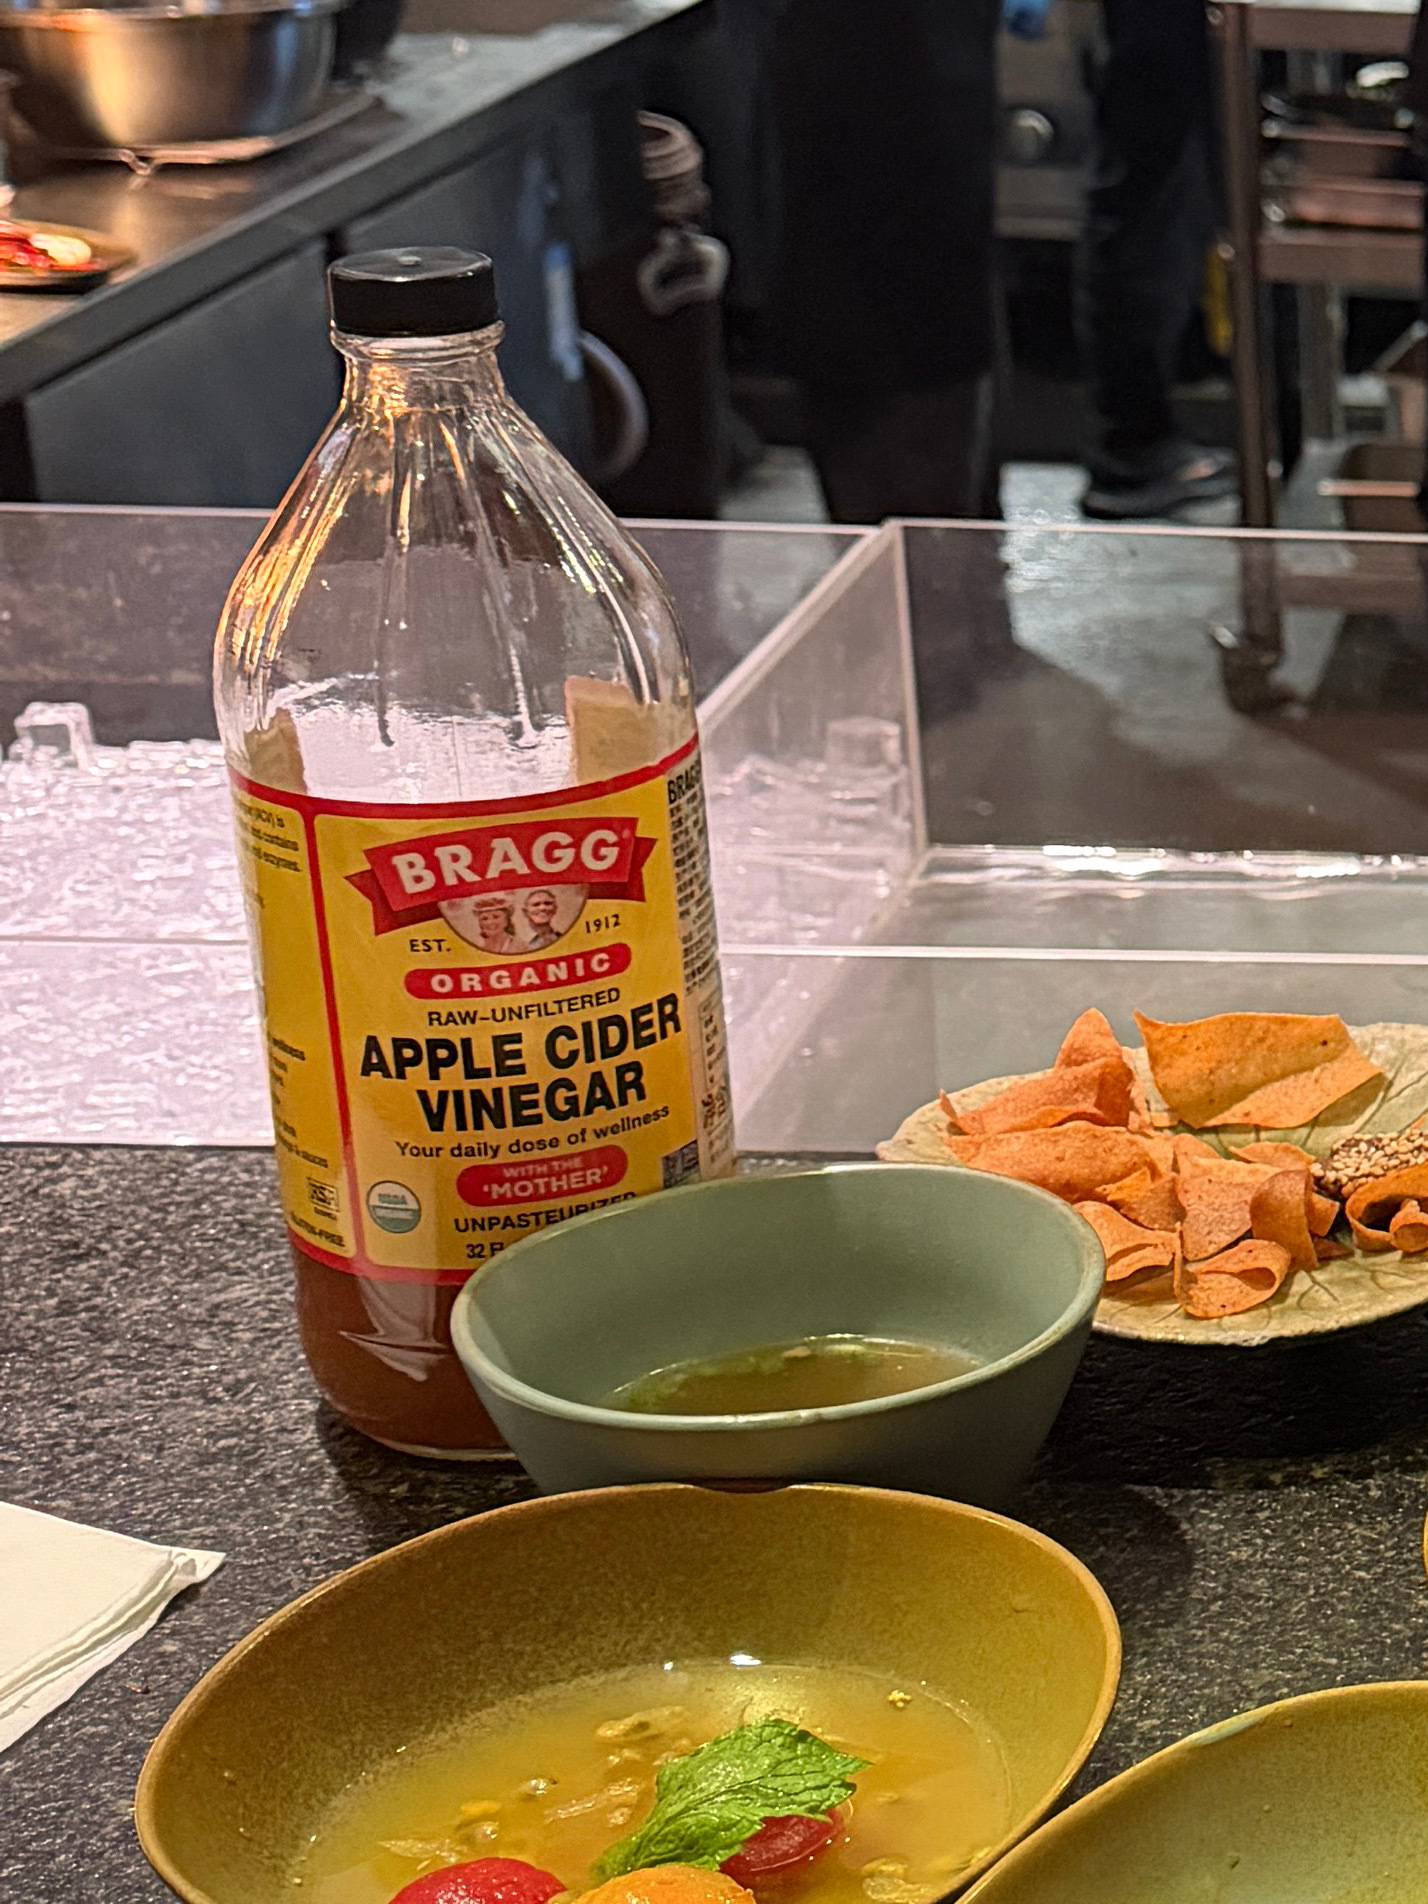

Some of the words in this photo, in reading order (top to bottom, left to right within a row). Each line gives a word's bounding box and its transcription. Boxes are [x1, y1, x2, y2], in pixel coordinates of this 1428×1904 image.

[391, 829, 621, 895] BRAGG
[409, 938, 452, 953] EST.
[584, 913, 621, 934] 1912
[430, 951, 611, 994] ORGANIC
[359, 1033, 525, 1081] APPLE
[544, 992, 682, 1071] CIDER
[416, 1061, 647, 1133] VINEGAR
[395, 1141, 442, 1159] Your
[450, 1141, 501, 1160] daily
[508, 1134, 560, 1154] dose
[566, 1127, 588, 1145] of
[593, 1103, 670, 1140] wellness
[502, 1163, 547, 1179] WITH
[551, 1155, 583, 1173] THE
[465, 1243, 485, 1259] 32
